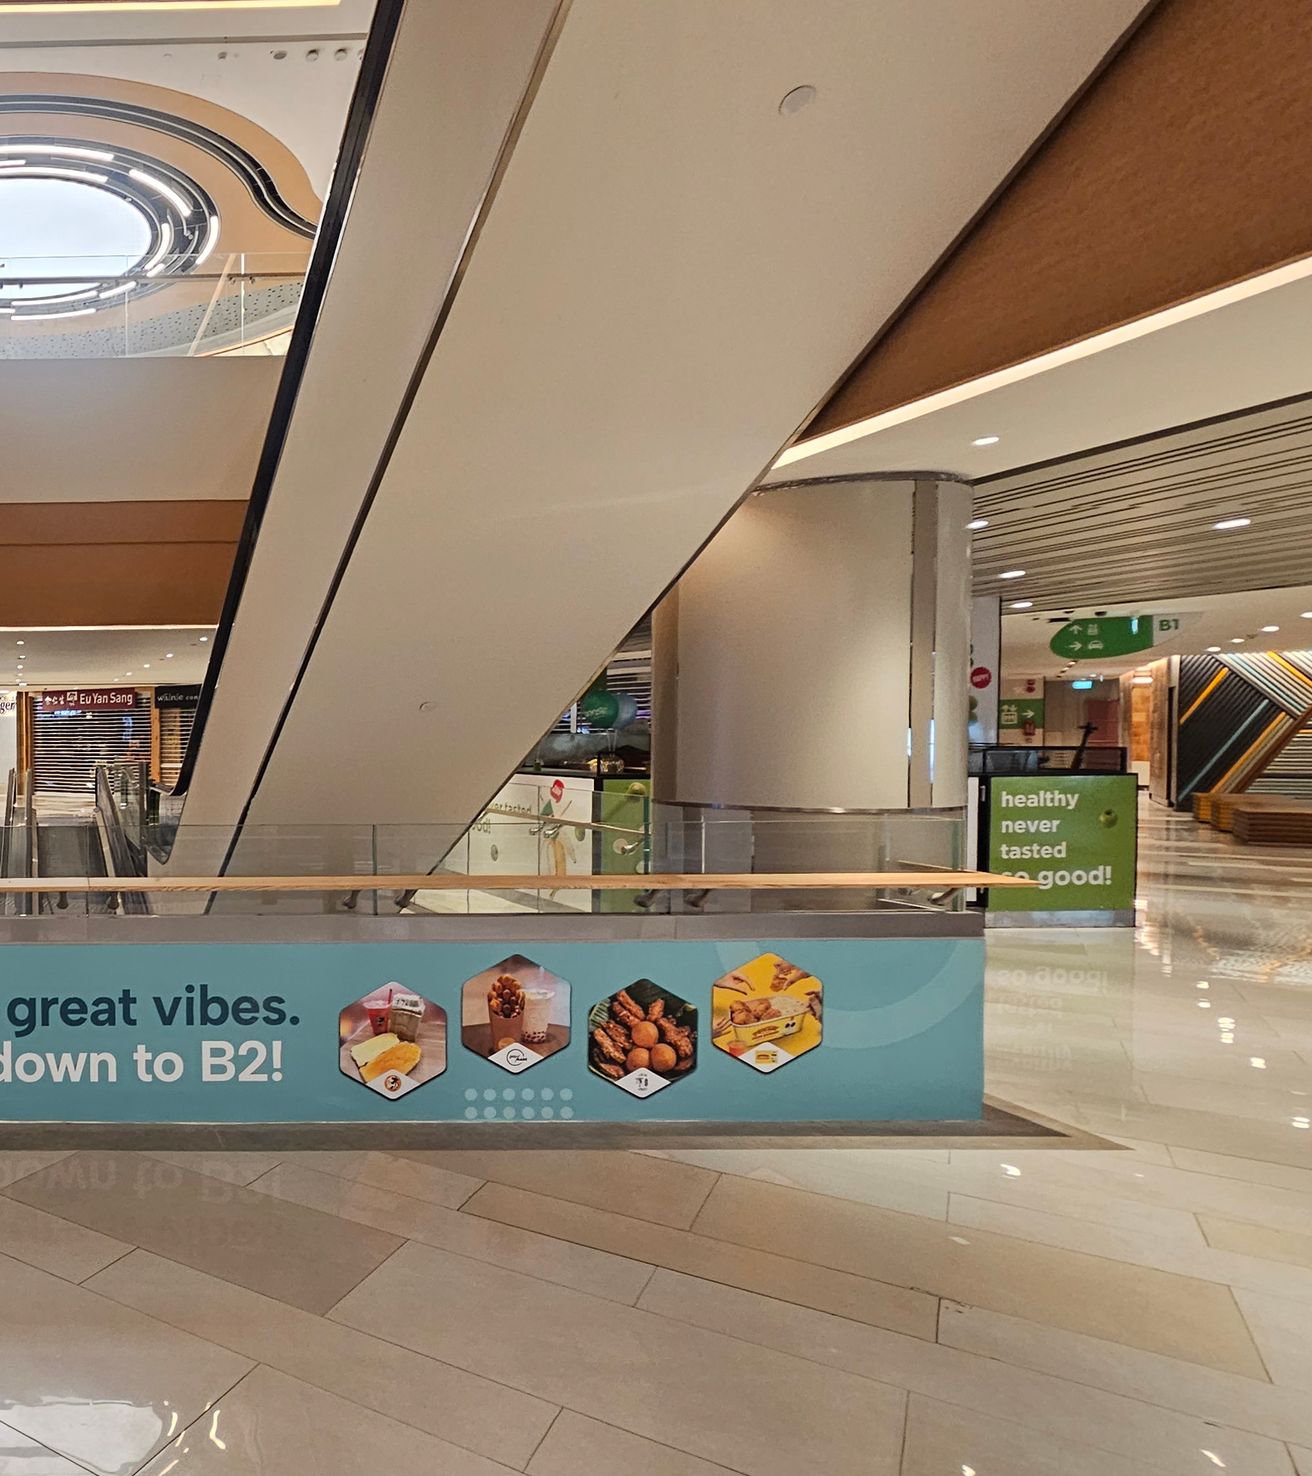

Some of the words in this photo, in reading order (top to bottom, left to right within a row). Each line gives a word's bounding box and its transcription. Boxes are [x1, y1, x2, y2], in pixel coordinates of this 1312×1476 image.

[1159, 619, 1179, 631] B1
[80, 693, 91, 704] Eu
[92, 693, 107, 704] Yan
[109, 692, 133, 705] Sang
[1001, 790, 1079, 810] healthy
[1001, 820, 1061, 833] never
[1000, 841, 1067, 859] tasted
[1037, 865, 1112, 890] good!
[7, 988, 138, 1038] great
[153, 984, 301, 1027] vibes.
[134, 1045, 185, 1083] to
[202, 1041, 284, 1082] B2!
